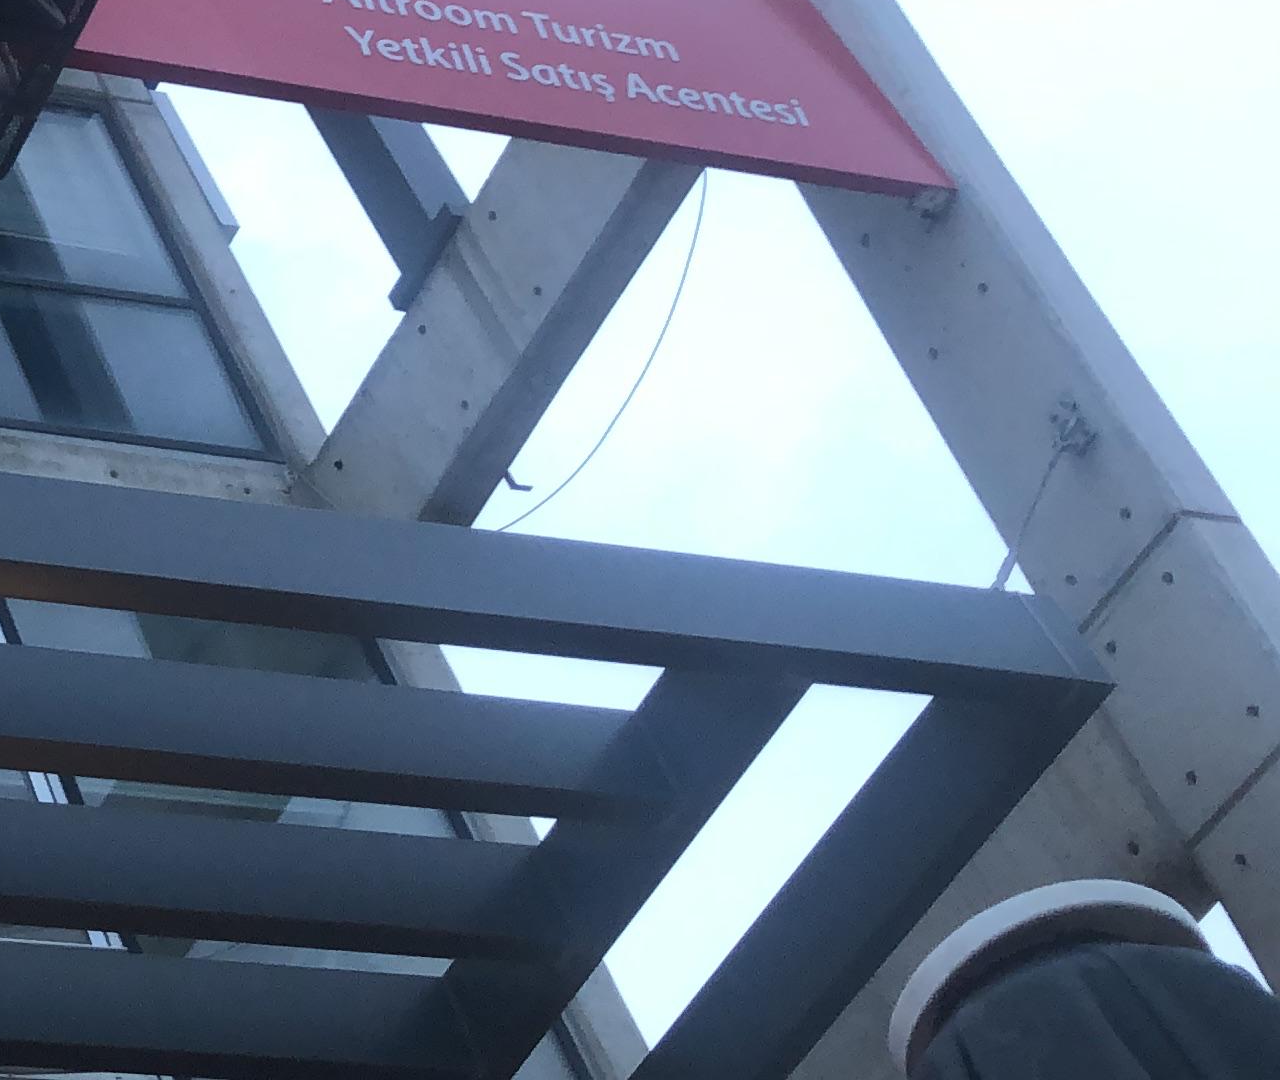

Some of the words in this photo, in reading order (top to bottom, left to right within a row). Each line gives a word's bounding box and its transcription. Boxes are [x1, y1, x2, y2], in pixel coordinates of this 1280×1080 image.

[521, 10, 681, 63] Turizm
[343, 24, 493, 77] Yetkili
[498, 51, 616, 103] Satış
[626, 73, 811, 128] Acentesi
